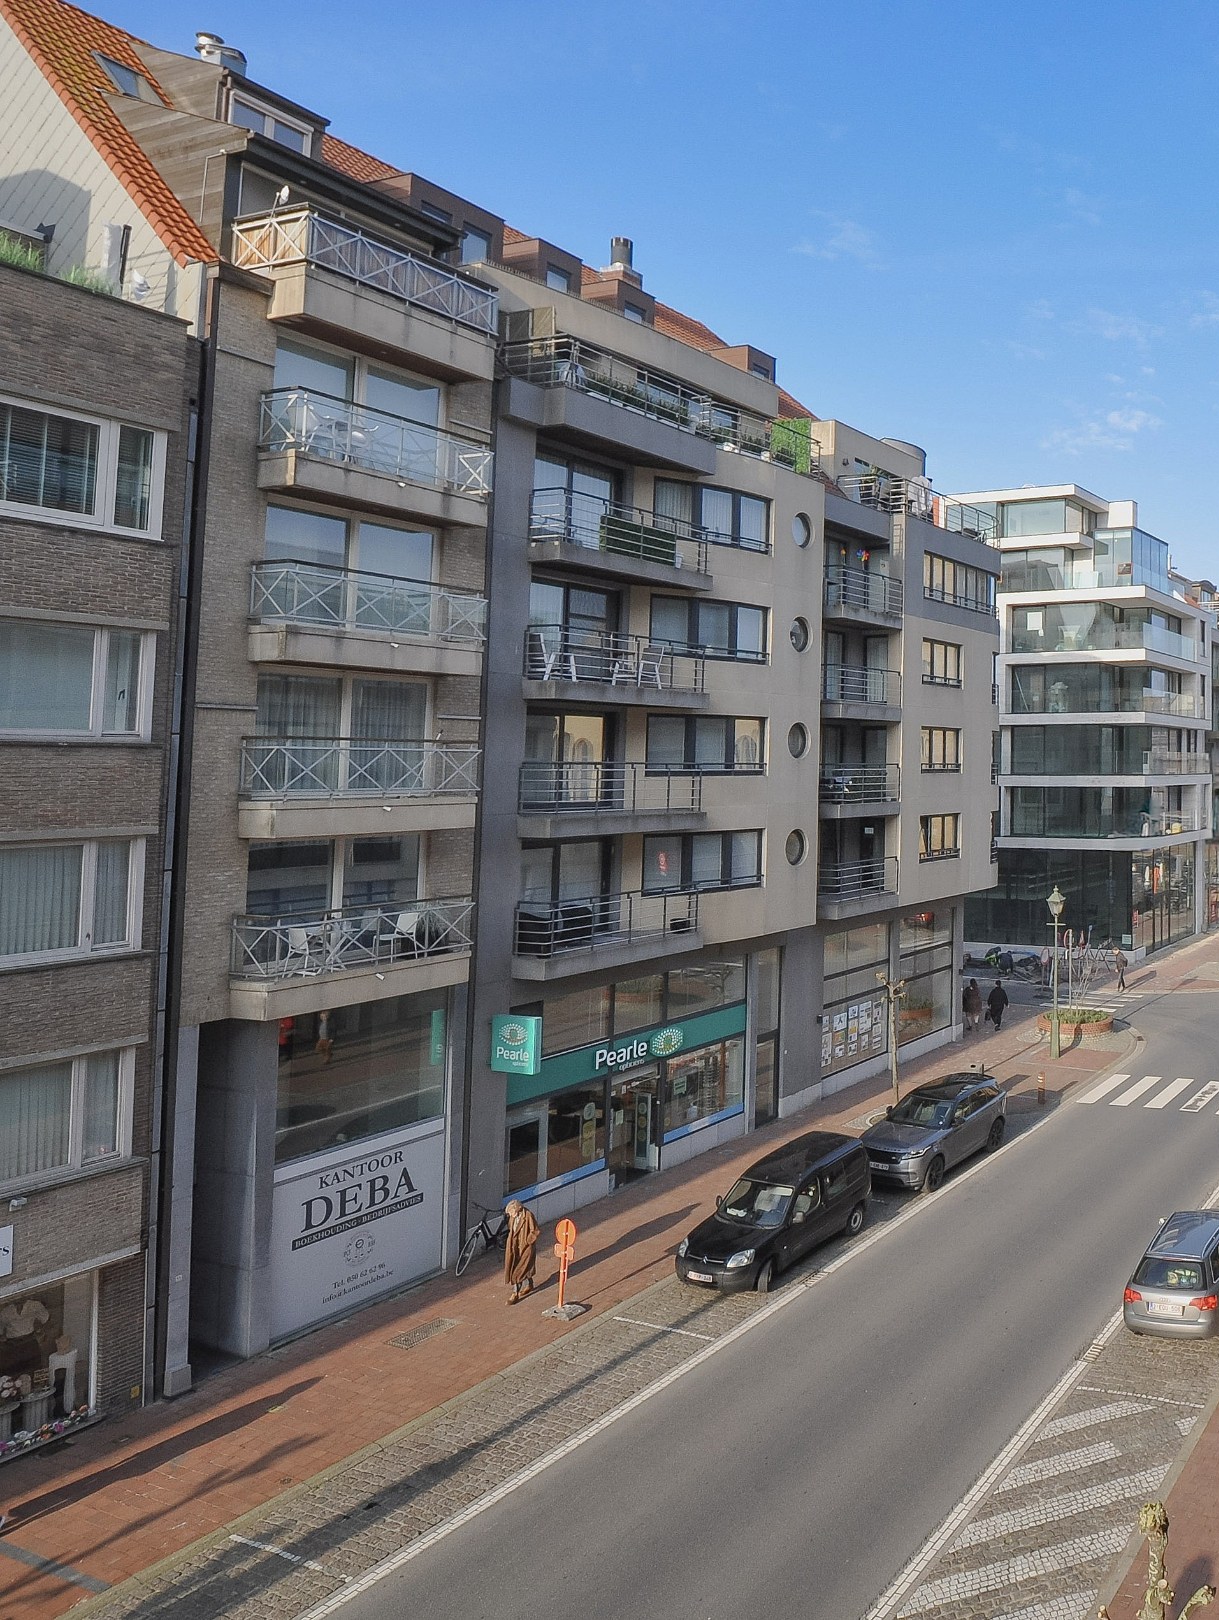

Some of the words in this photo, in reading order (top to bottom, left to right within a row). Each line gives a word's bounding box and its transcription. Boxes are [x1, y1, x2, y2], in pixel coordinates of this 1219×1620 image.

[496, 1047, 530, 1062] Pearle
[595, 1040, 648, 1070] Pearle
[318, 1150, 404, 1189] KANTOOR
[300, 1167, 418, 1233] DEBA
[295, 1219, 357, 1249] BOEKHOUDING
[362, 1194, 423, 1223] BEDRIJFSADVIES
[332, 1279, 345, 1289] Tel.
[360, 1269, 368, 1278] 62
